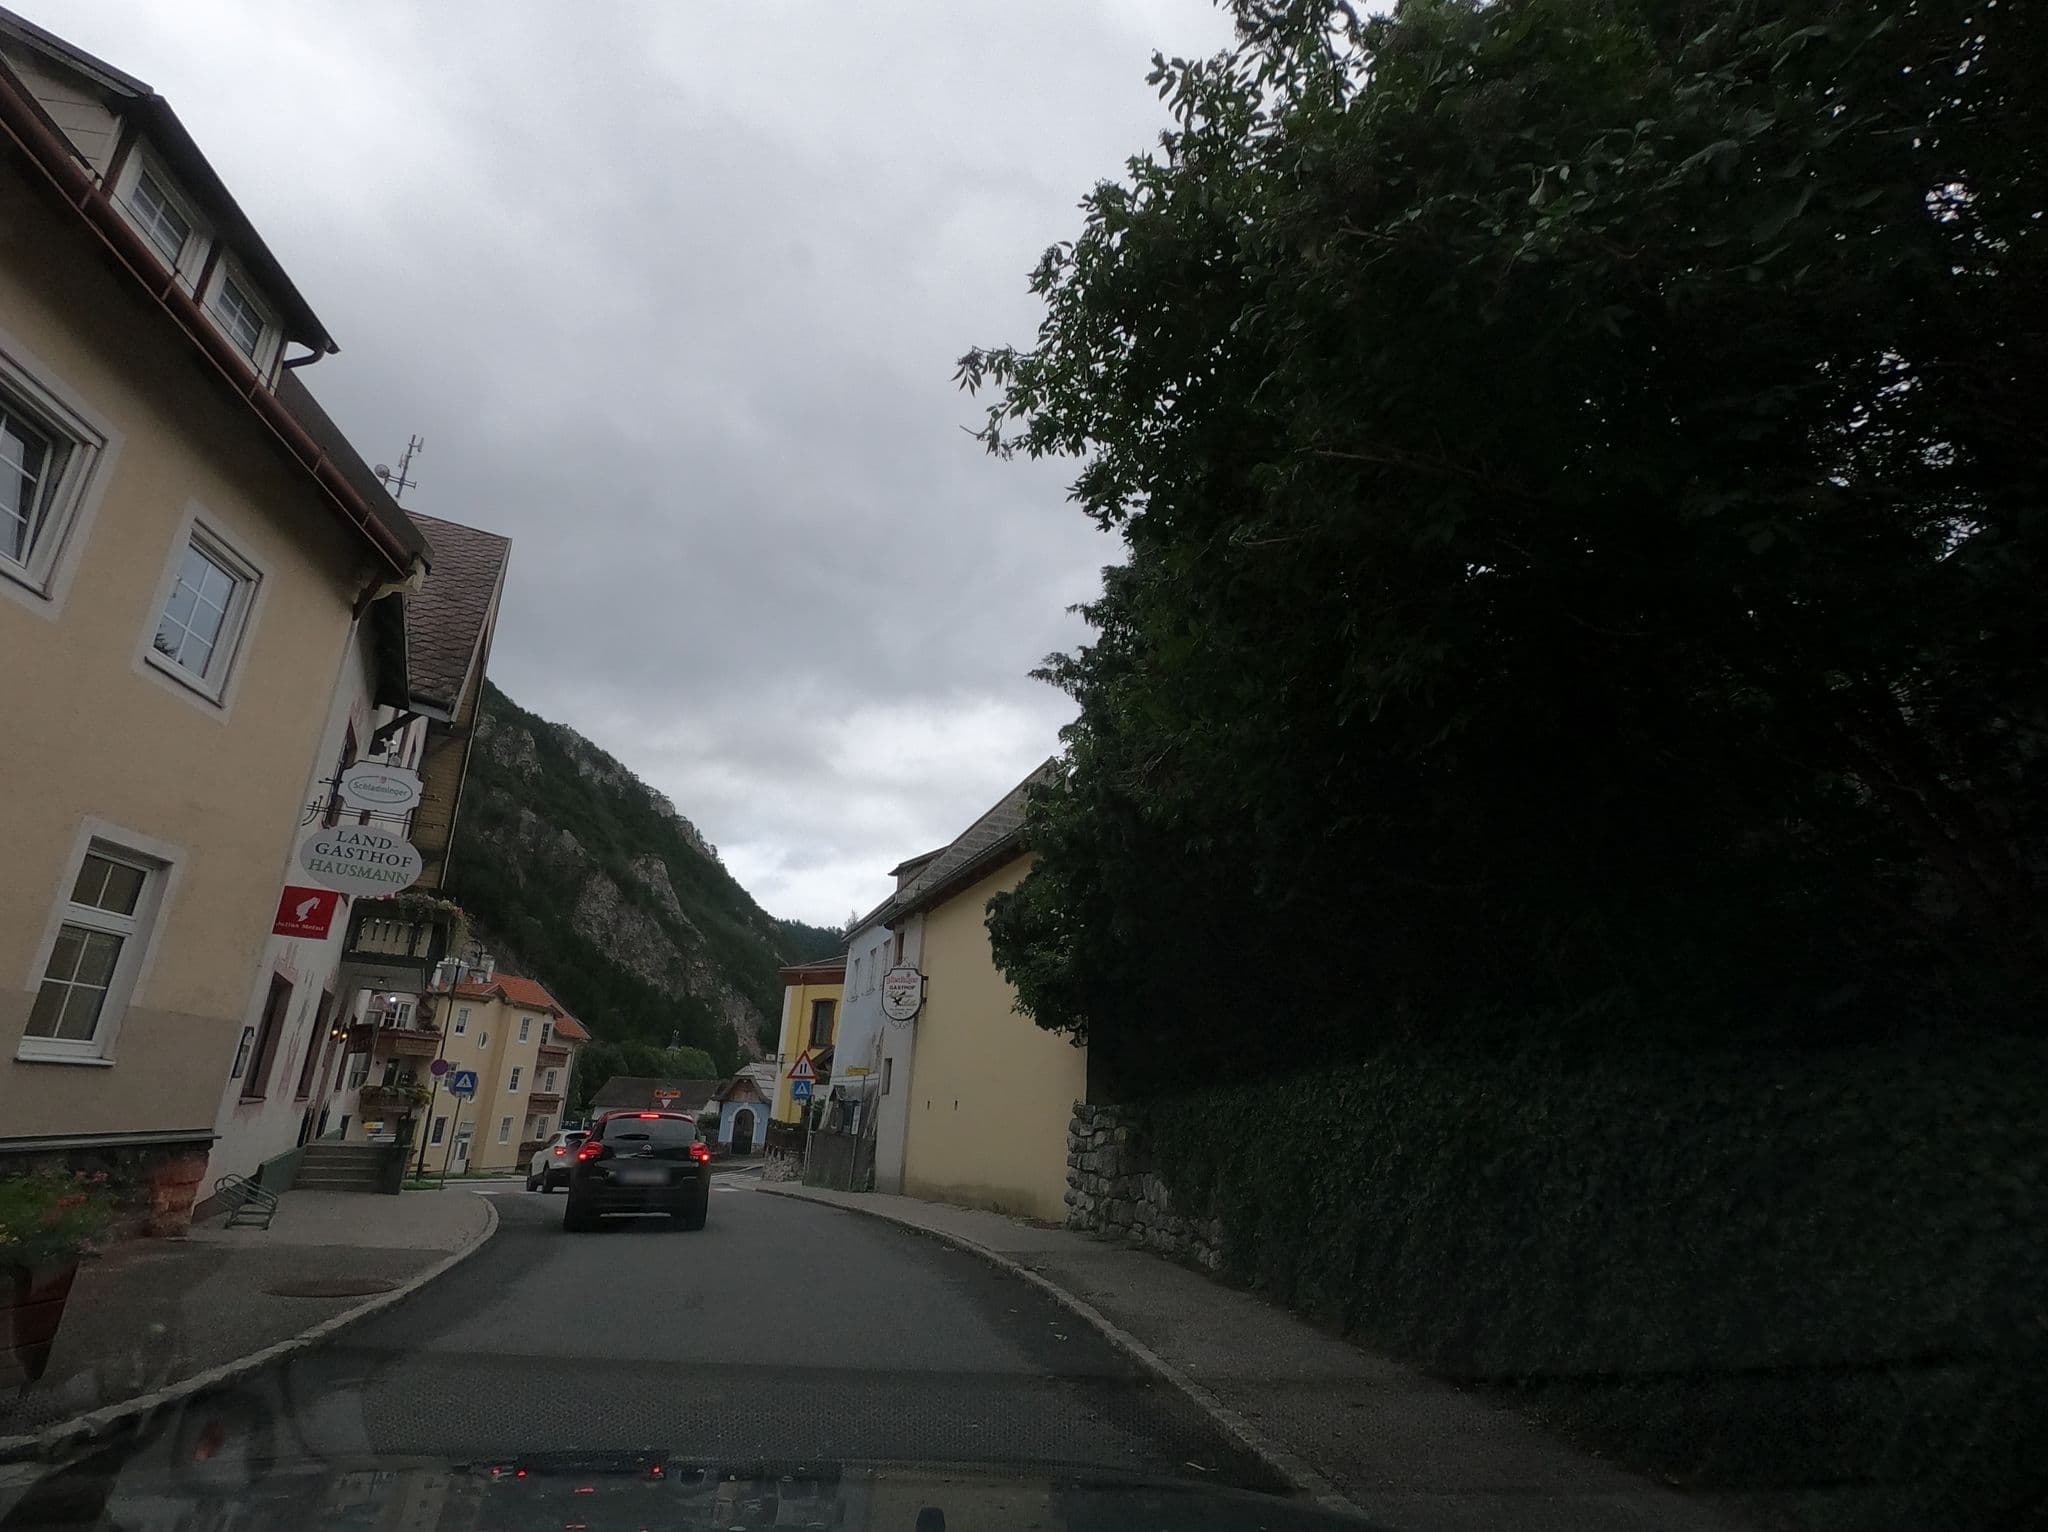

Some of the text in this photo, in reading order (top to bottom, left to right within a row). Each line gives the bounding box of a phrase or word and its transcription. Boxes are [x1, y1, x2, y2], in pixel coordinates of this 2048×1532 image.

[336, 831, 398, 849] LAND-
[315, 843, 412, 867] GASTHOF
[308, 859, 409, 885] HAUSMANN
